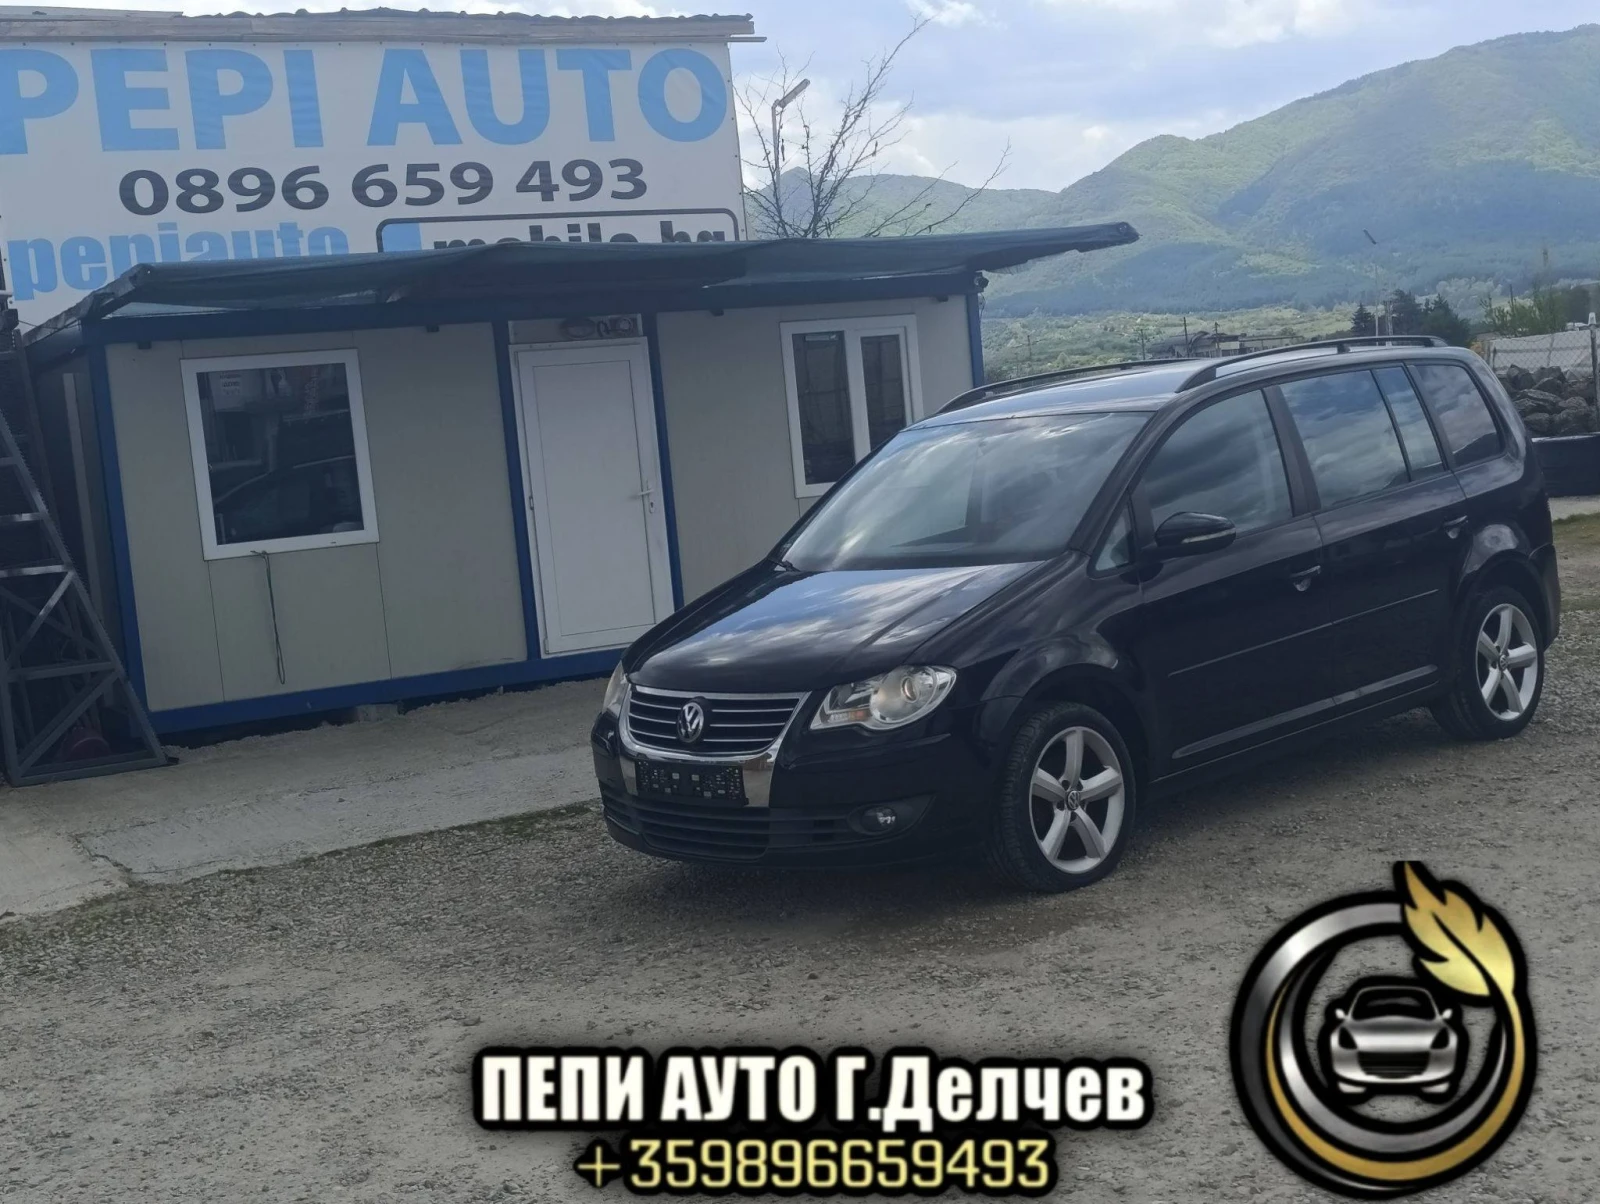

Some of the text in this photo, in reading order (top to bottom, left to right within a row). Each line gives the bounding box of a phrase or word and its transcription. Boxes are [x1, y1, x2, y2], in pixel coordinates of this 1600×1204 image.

[0, 47, 729, 155] PEPI AUTO
[119, 158, 648, 216] 0896 659 493
